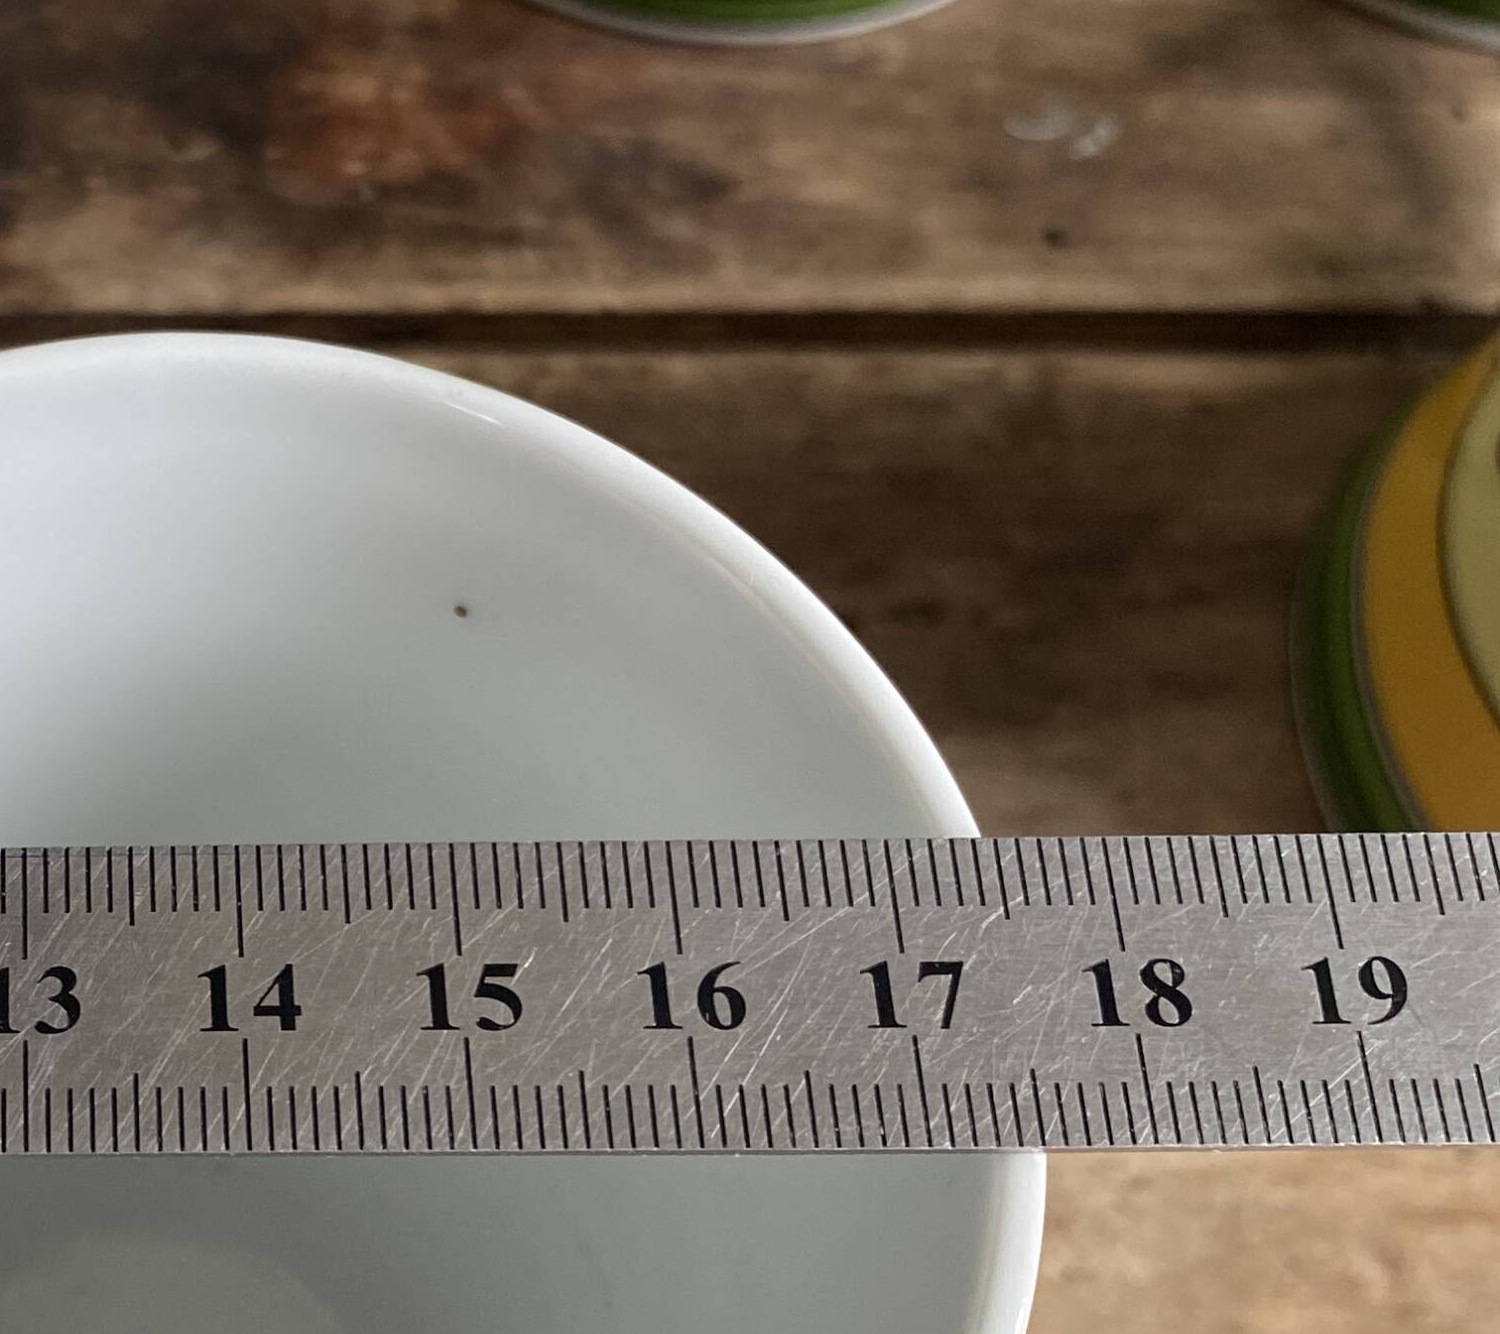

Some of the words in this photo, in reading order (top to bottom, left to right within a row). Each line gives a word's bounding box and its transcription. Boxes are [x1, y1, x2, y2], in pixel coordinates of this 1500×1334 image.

[198, 964, 301, 1031] 14
[416, 963, 522, 1031] 15
[637, 962, 746, 1030] 16
[860, 961, 963, 1029] 17
[1082, 959, 1192, 1027] 18
[1302, 956, 1407, 1025] 19
